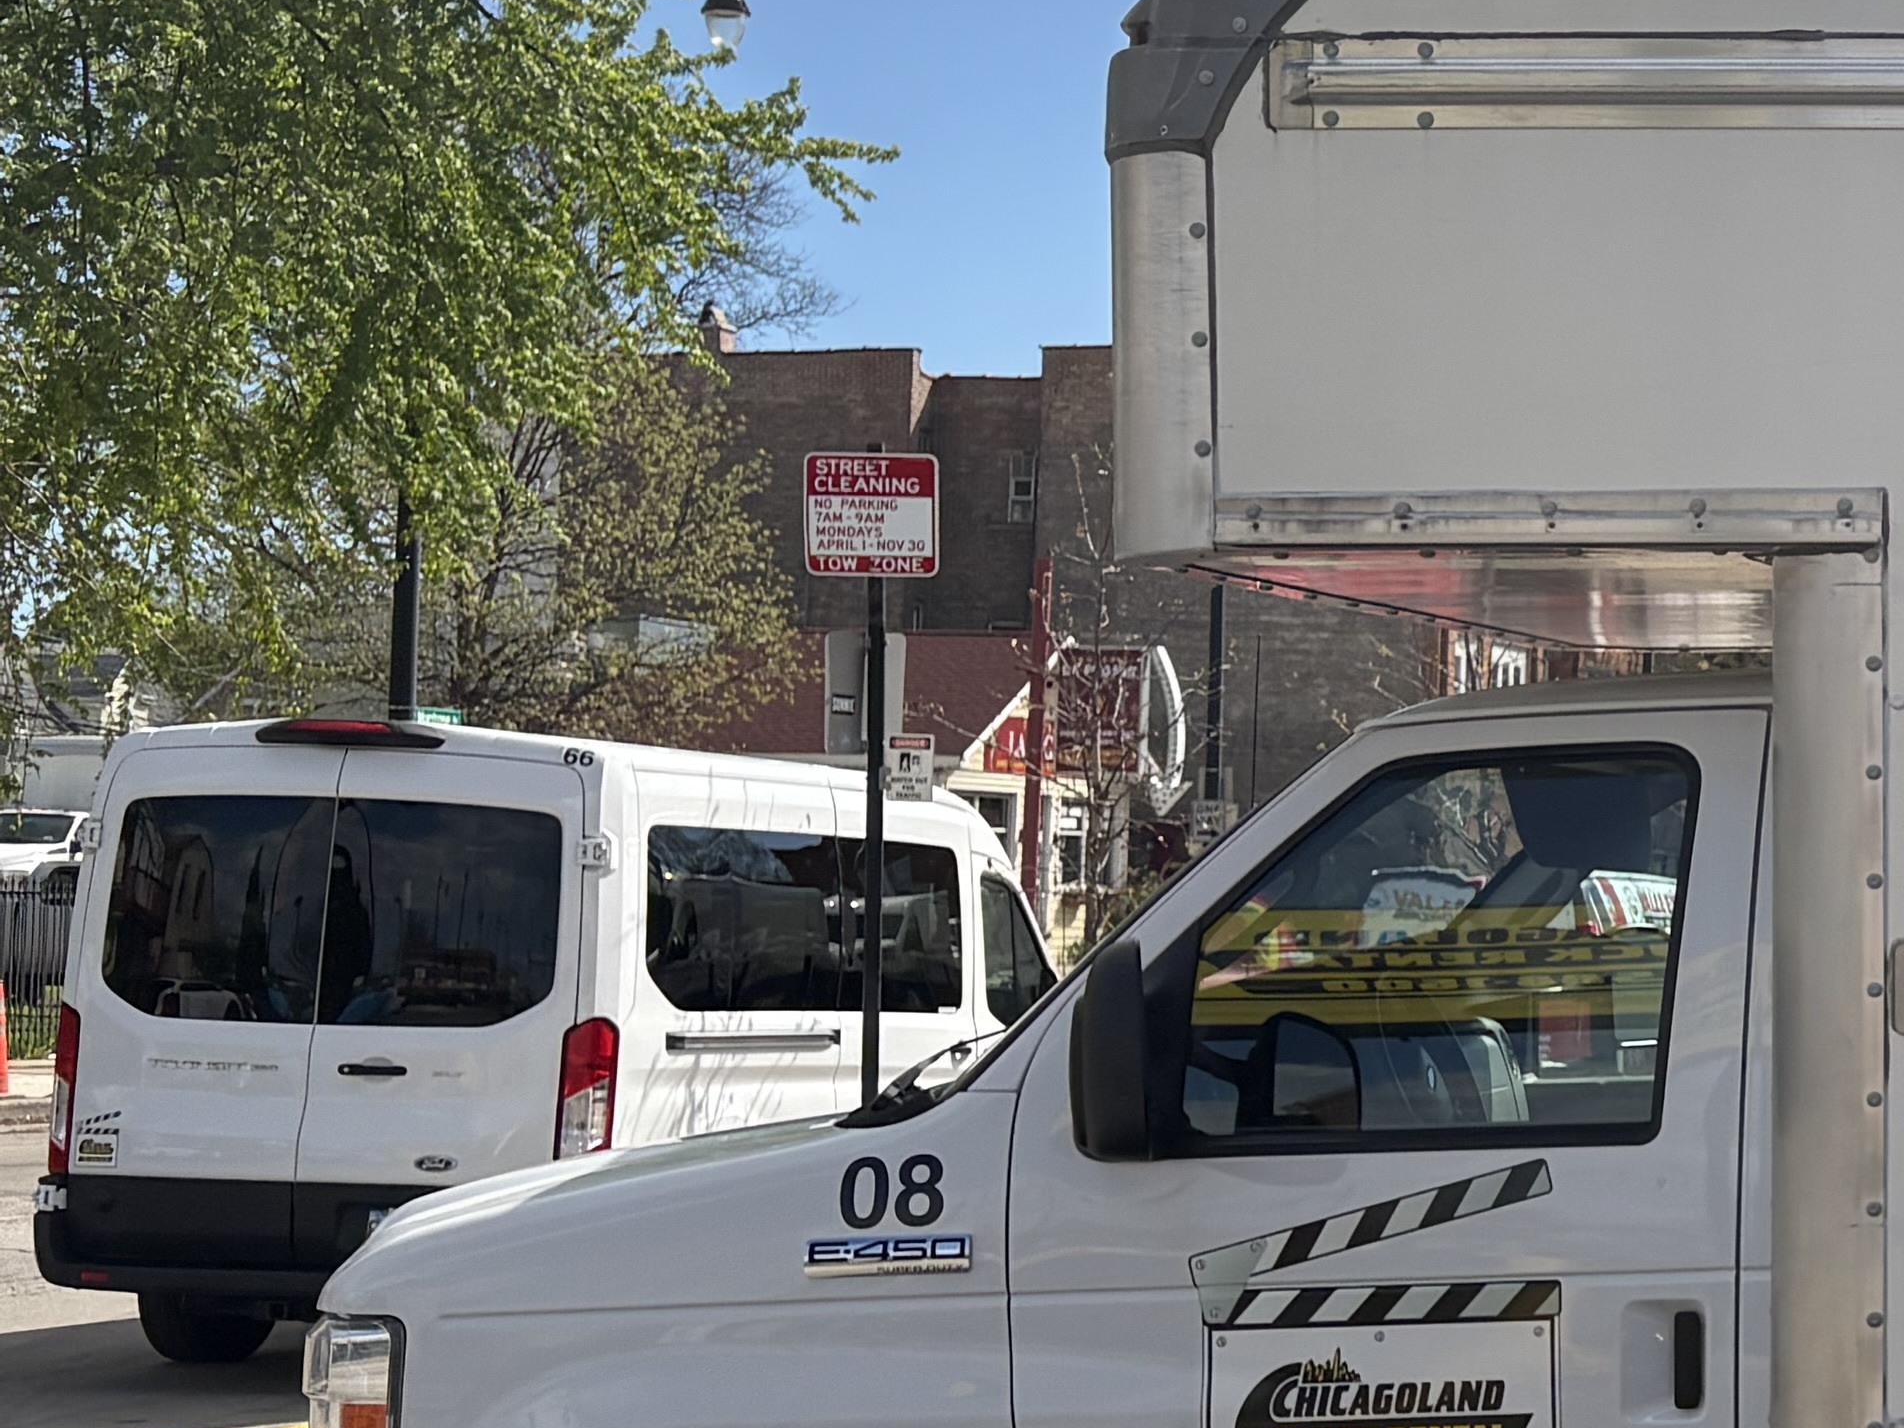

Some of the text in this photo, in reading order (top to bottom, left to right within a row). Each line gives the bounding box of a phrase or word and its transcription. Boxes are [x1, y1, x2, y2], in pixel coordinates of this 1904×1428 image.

[815, 459, 890, 476] STREET
[814, 477, 920, 494] CLEANING
[814, 498, 899, 510] NO PARKING
[815, 512, 843, 523] 7AM
[854, 513, 885, 523] 9AM
[815, 526, 884, 538] MONDAYS
[817, 540, 857, 551] APRIL
[876, 540, 905, 552] NOV
[907, 540, 925, 552] 30
[817, 556, 925, 572] TOW ZONE
[563, 748, 595, 767] 66
[840, 1153, 944, 1229] 08
[1271, 1375, 1506, 1418] CHICAGOLAND
